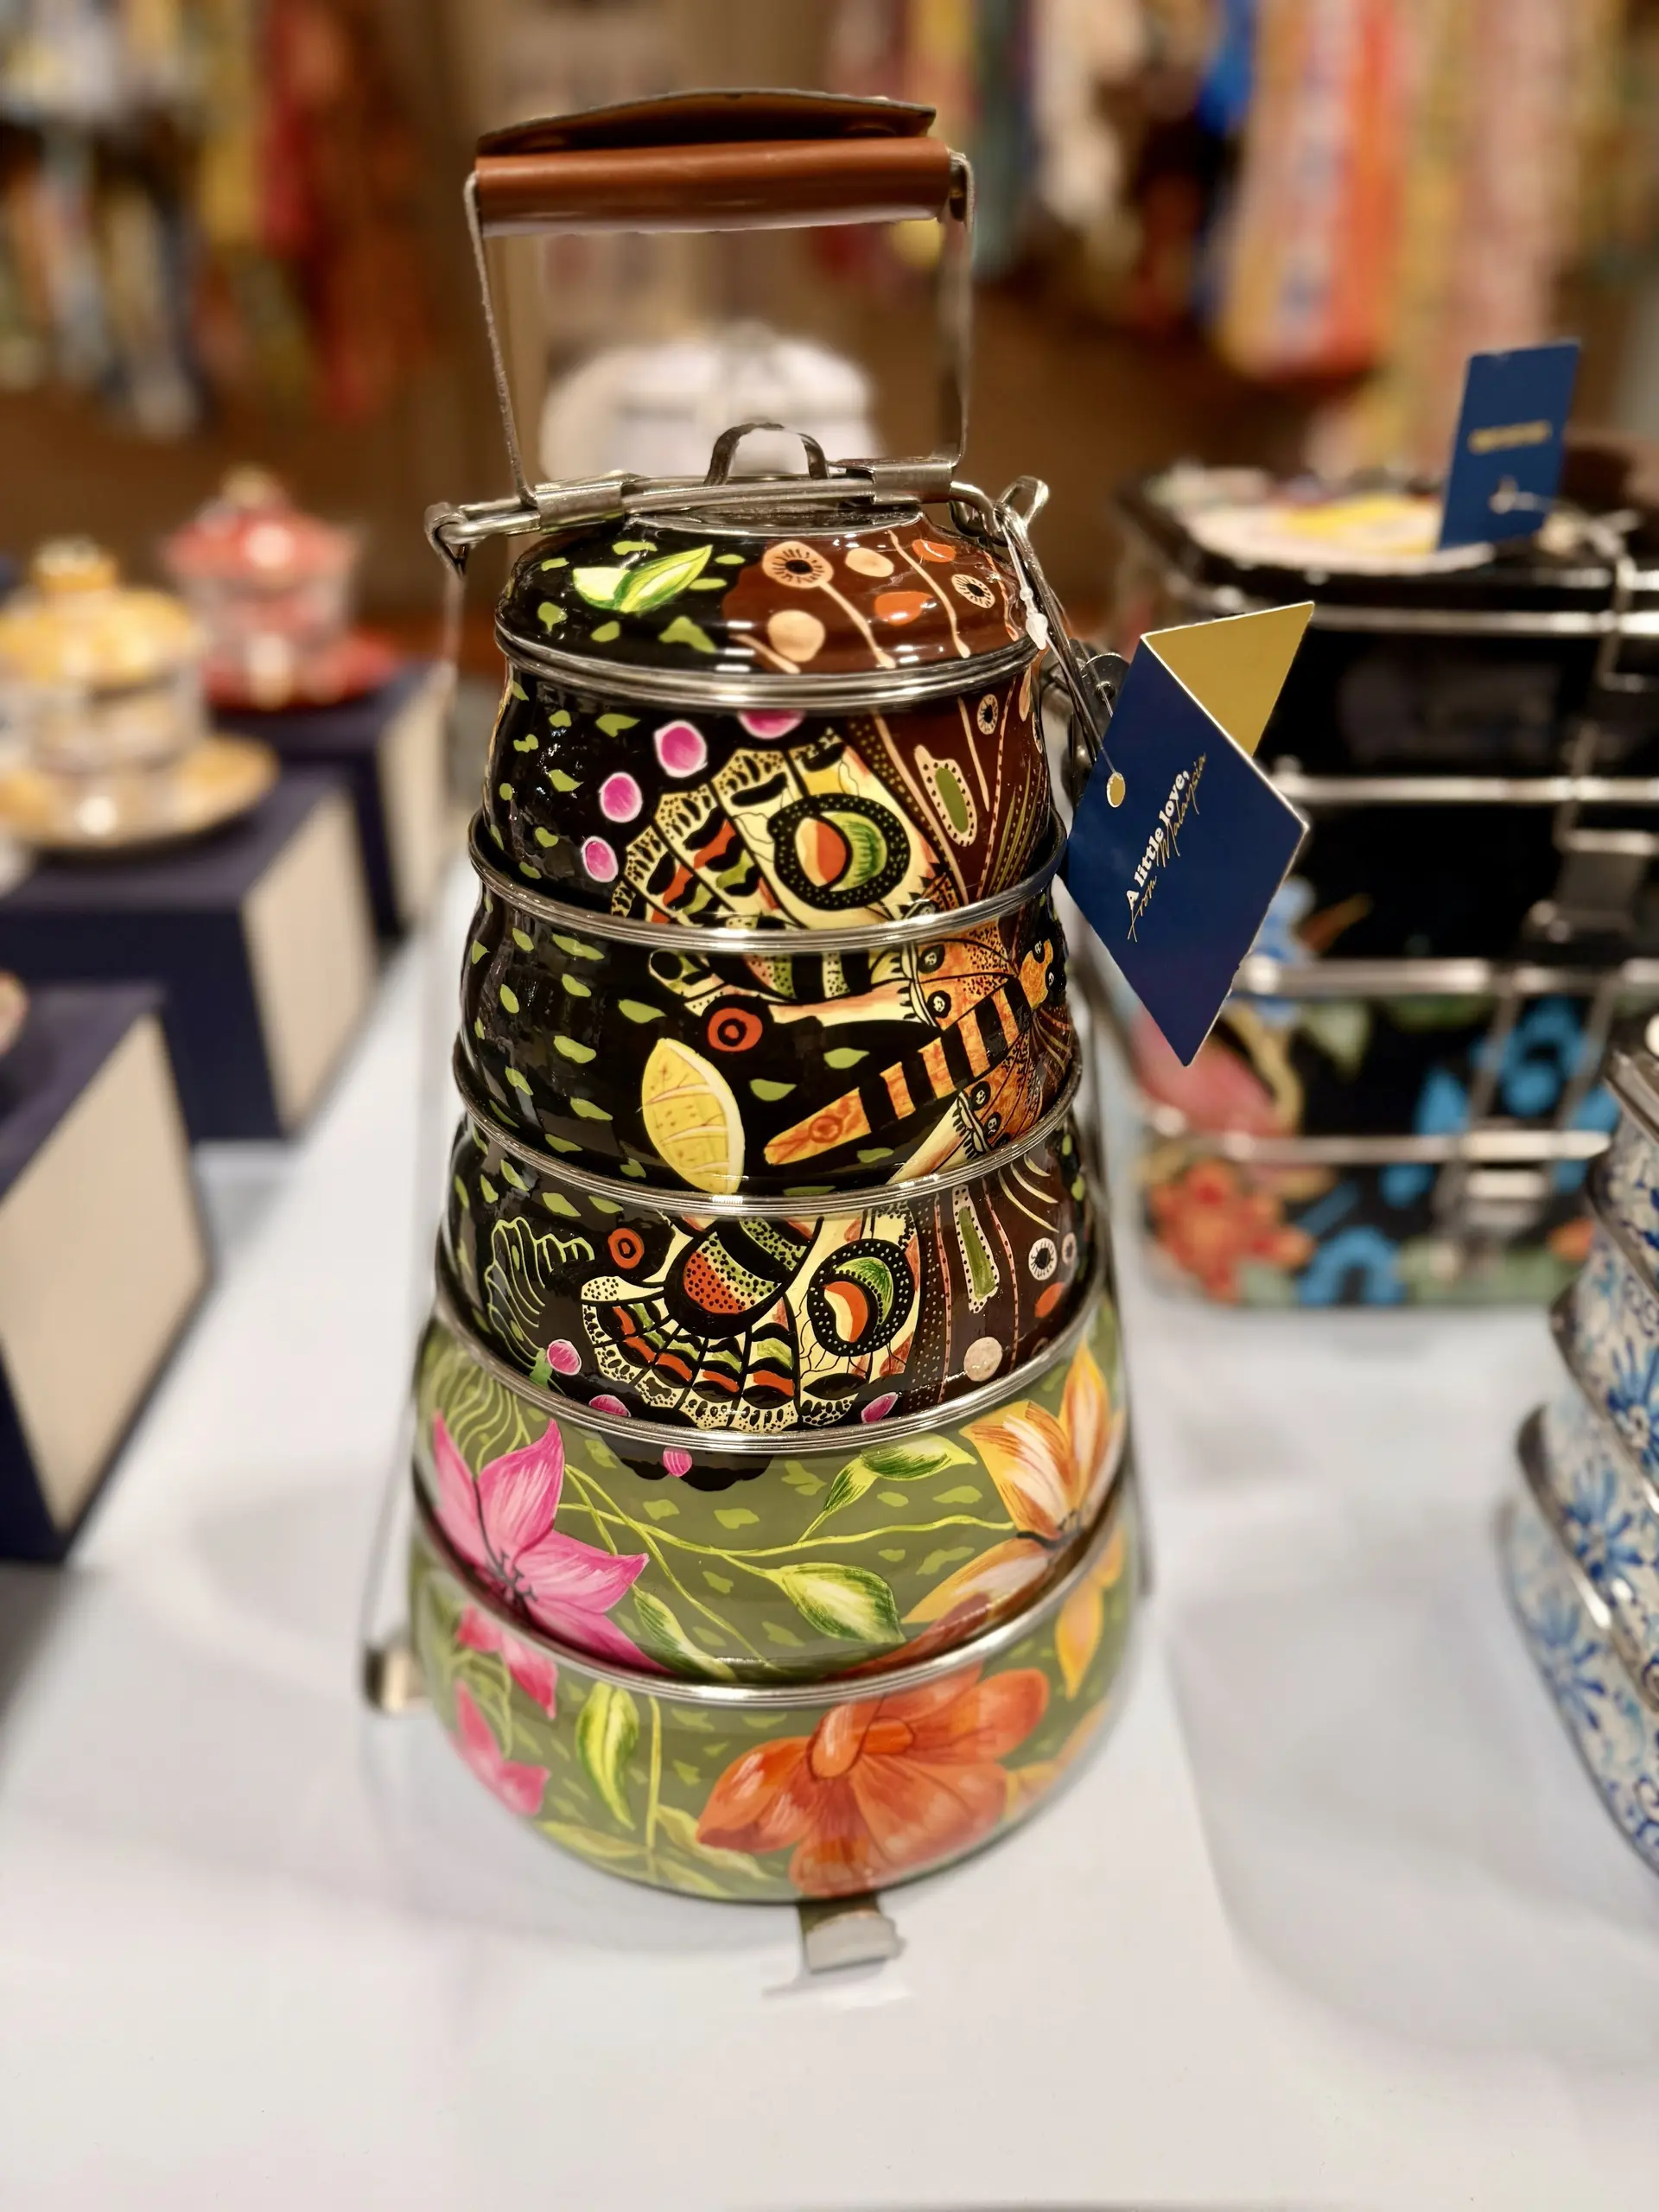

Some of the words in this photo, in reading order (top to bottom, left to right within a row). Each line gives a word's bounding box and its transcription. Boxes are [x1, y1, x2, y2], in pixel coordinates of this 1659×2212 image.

[1126, 889, 1140, 910] A
[1134, 827, 1164, 887] little
[1159, 770, 1190, 827] love,
[1156, 752, 1206, 868] Malaysia
